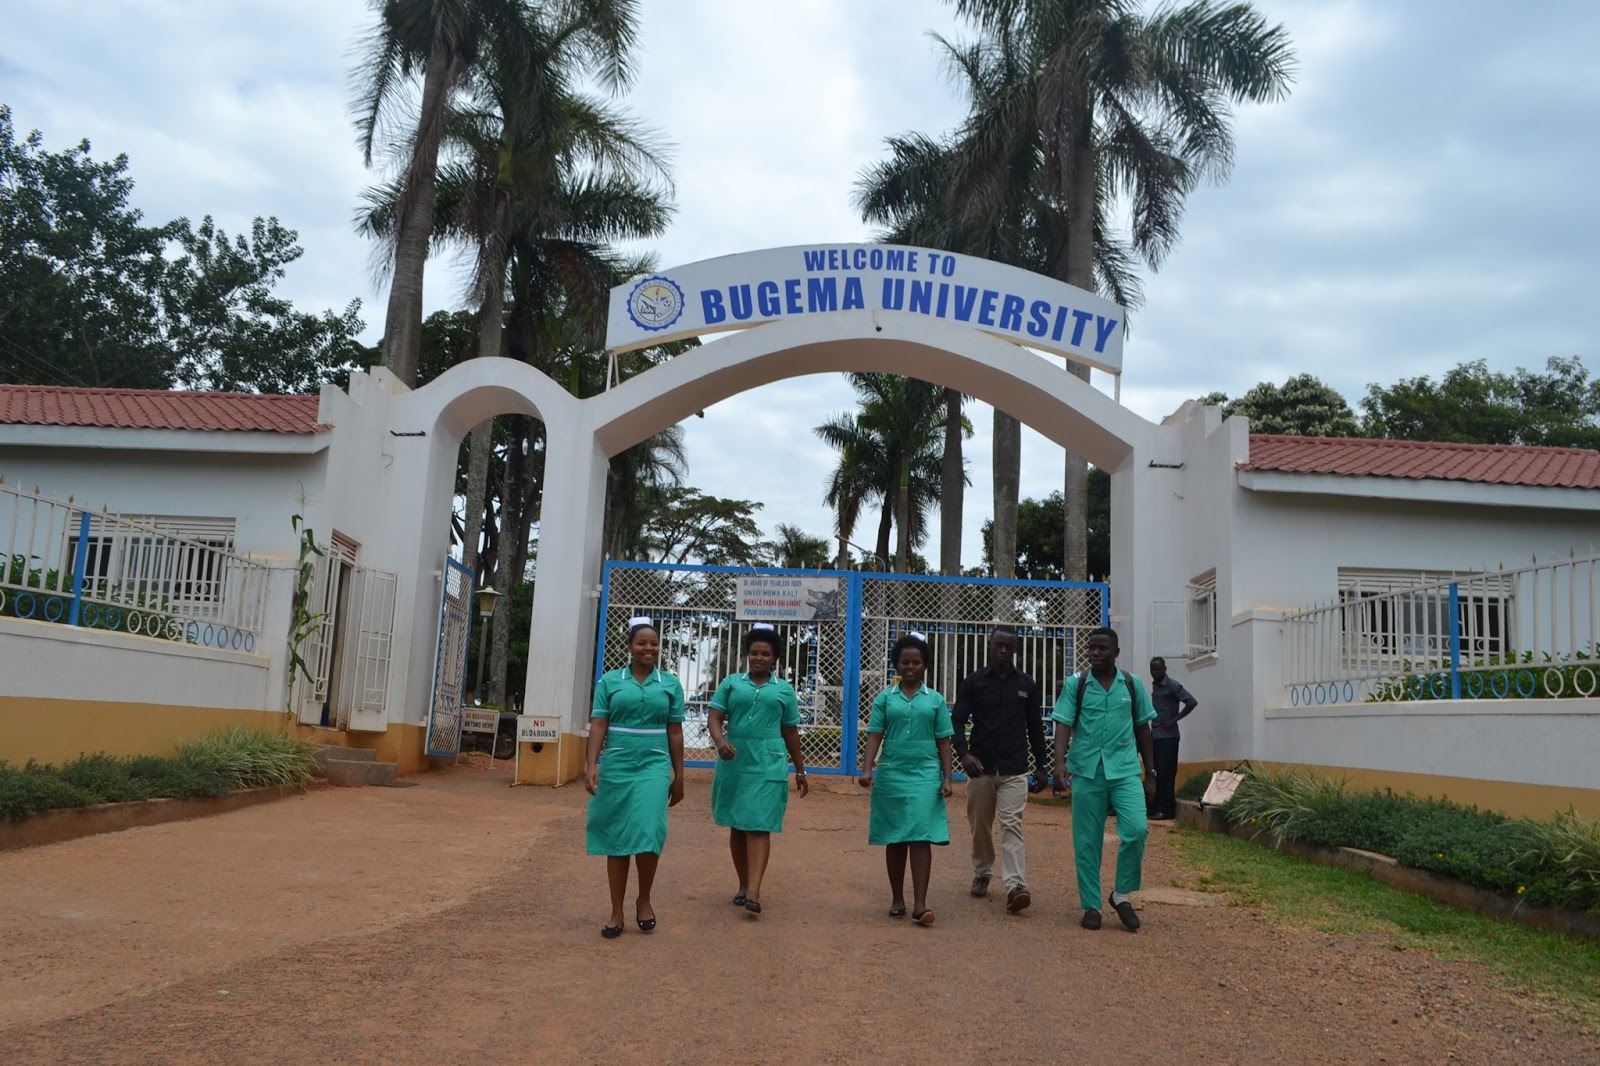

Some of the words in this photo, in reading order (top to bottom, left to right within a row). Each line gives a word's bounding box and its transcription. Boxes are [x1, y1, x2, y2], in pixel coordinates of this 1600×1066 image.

[804, 248, 918, 272] WELCOME
[928, 253, 956, 277] TO
[700, 277, 865, 325] BUGEMA
[882, 277, 1118, 353] UNIVERSITY
